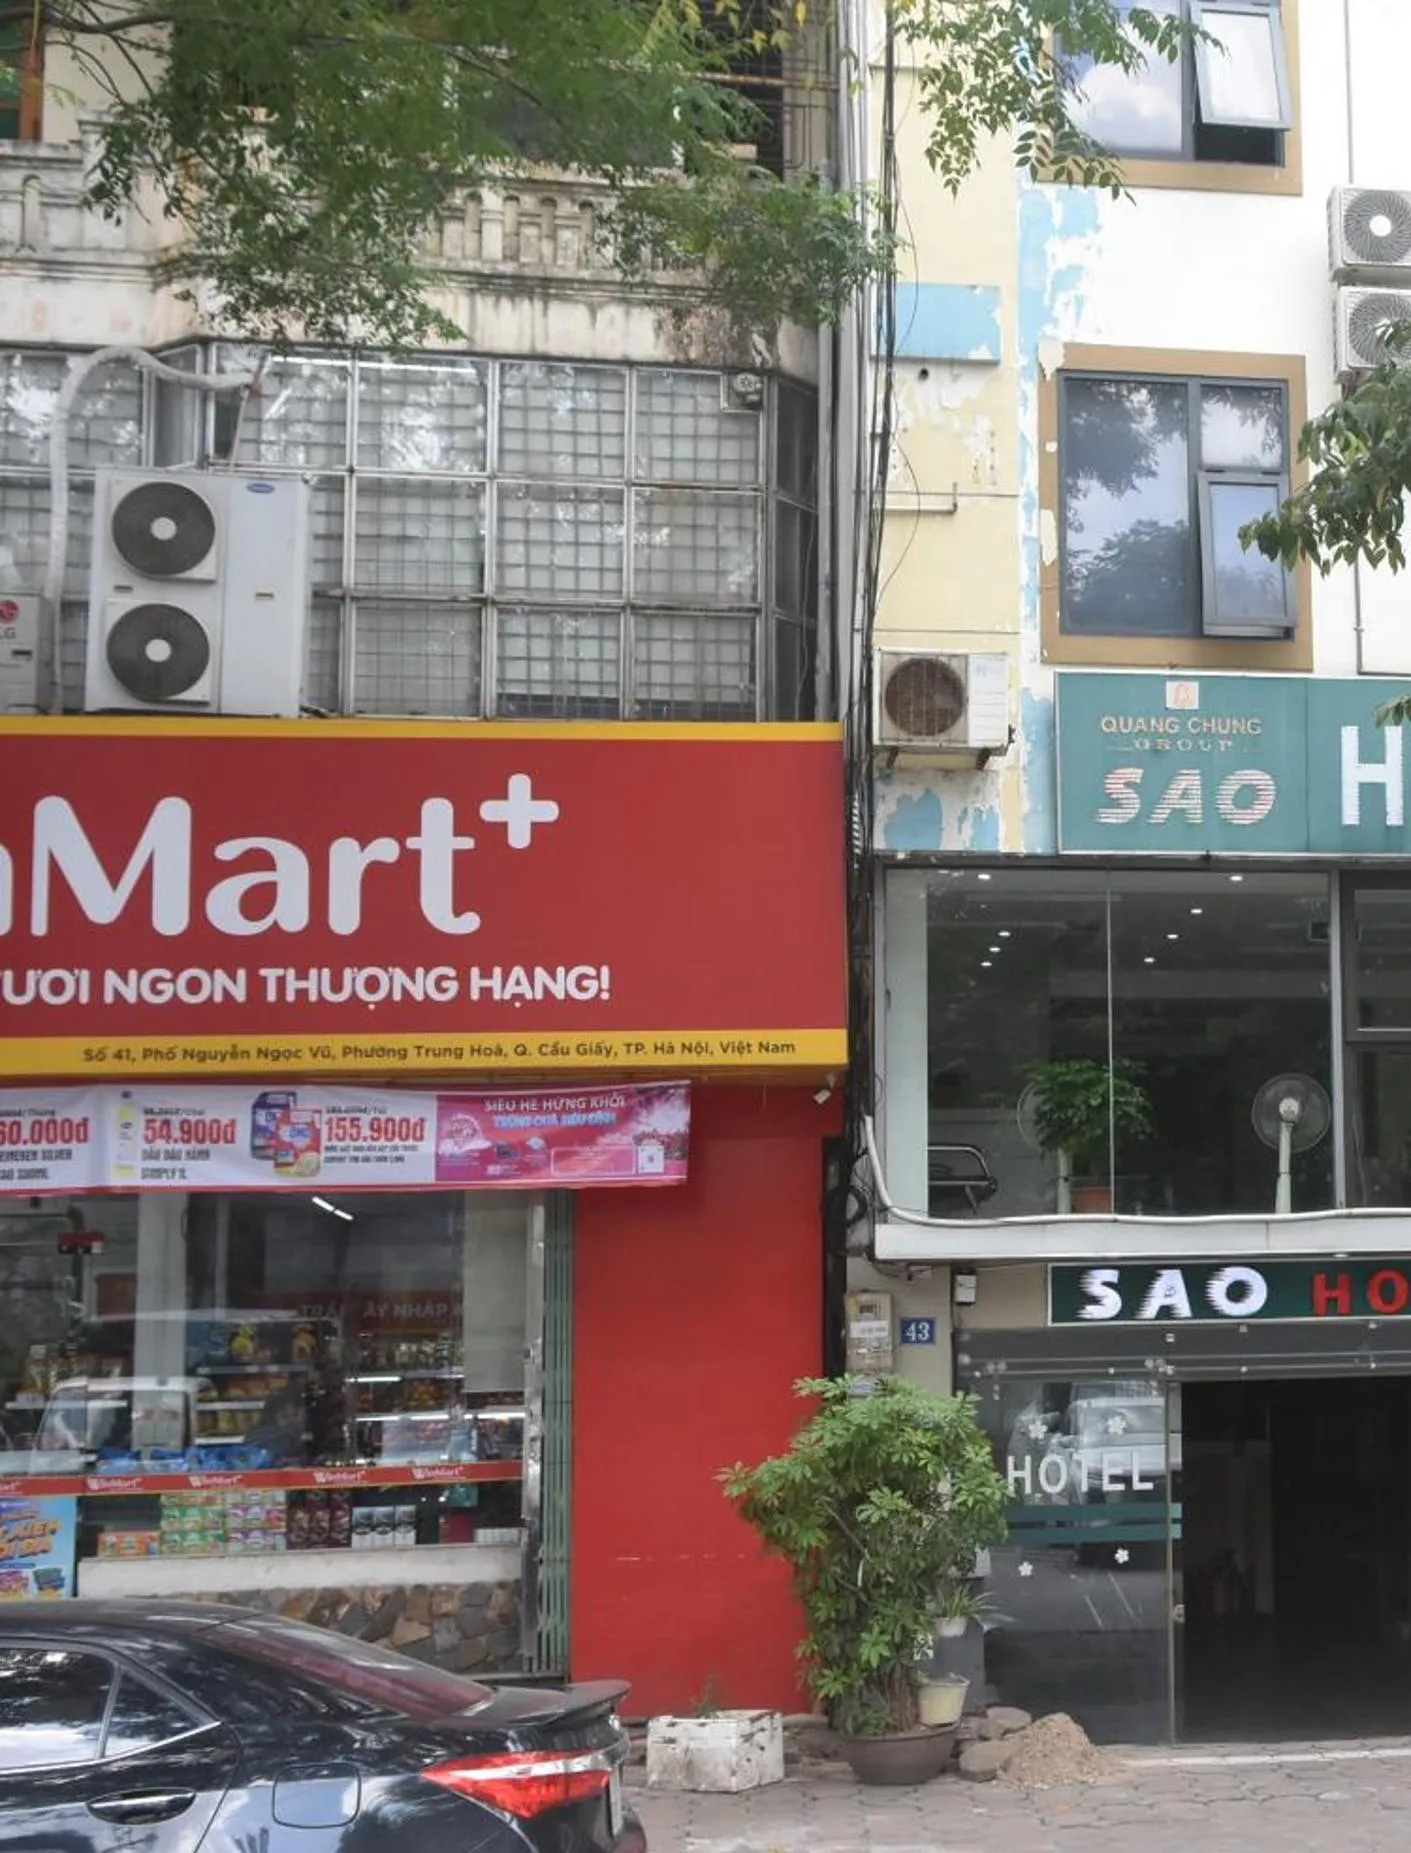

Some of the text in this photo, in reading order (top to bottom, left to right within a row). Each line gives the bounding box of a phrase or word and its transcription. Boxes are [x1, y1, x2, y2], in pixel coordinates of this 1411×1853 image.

[1101, 716, 1262, 734] QUANG CHUNG
[1096, 767, 1276, 824] SAO
[0, 965, 610, 1010] ƯƠI NGON THƯỢNG HẠNG!
[84, 1047, 106, 1062] Số
[142, 1045, 176, 1061] Phố
[182, 1043, 250, 1062] Nguyễn
[256, 1047, 303, 1062] Ngọc
[414, 1045, 464, 1059] Trung
[513, 1043, 532, 1056] Q.
[624, 1042, 648, 1055] TP.
[681, 1039, 713, 1057] Nội,
[719, 1040, 752, 1056] Việt
[758, 1040, 797, 1055] Nam
[144, 1118, 236, 1145] 54.900đ
[326, 1117, 426, 1143] 155.900đ
[1075, 1266, 1268, 1320] SAO
[905, 1321, 930, 1341] 43
[1007, 1452, 1154, 1494] HOTEL
